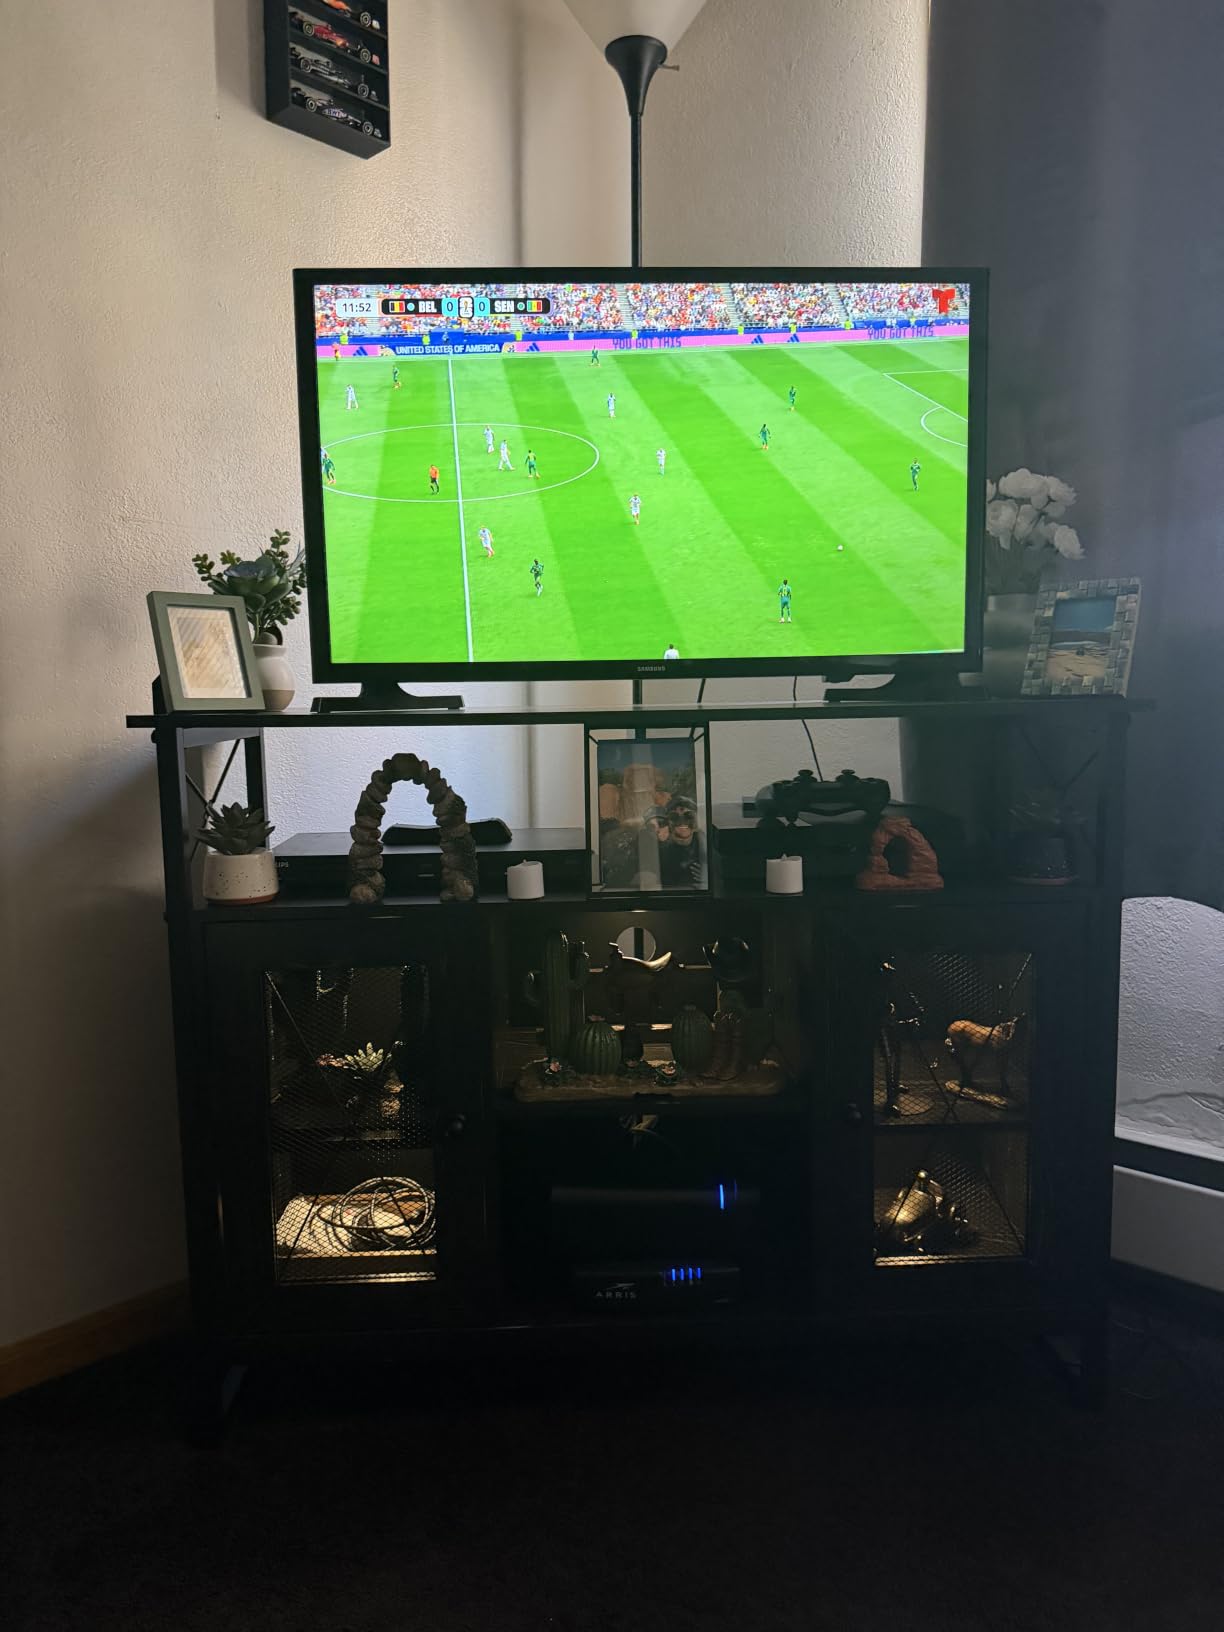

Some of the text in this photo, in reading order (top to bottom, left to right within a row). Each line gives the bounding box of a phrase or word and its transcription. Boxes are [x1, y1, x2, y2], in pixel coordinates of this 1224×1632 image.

[342, 302, 372, 313] 11:52
[418, 300, 515, 313] BEL 0 0 SEN
[867, 325, 934, 340] YOU GOT THIS
[395, 344, 500, 354] UNITED STATES OF AMERICA
[612, 336, 682, 350] YOU GOT THIS
[595, 1290, 636, 1300] ARRIS
